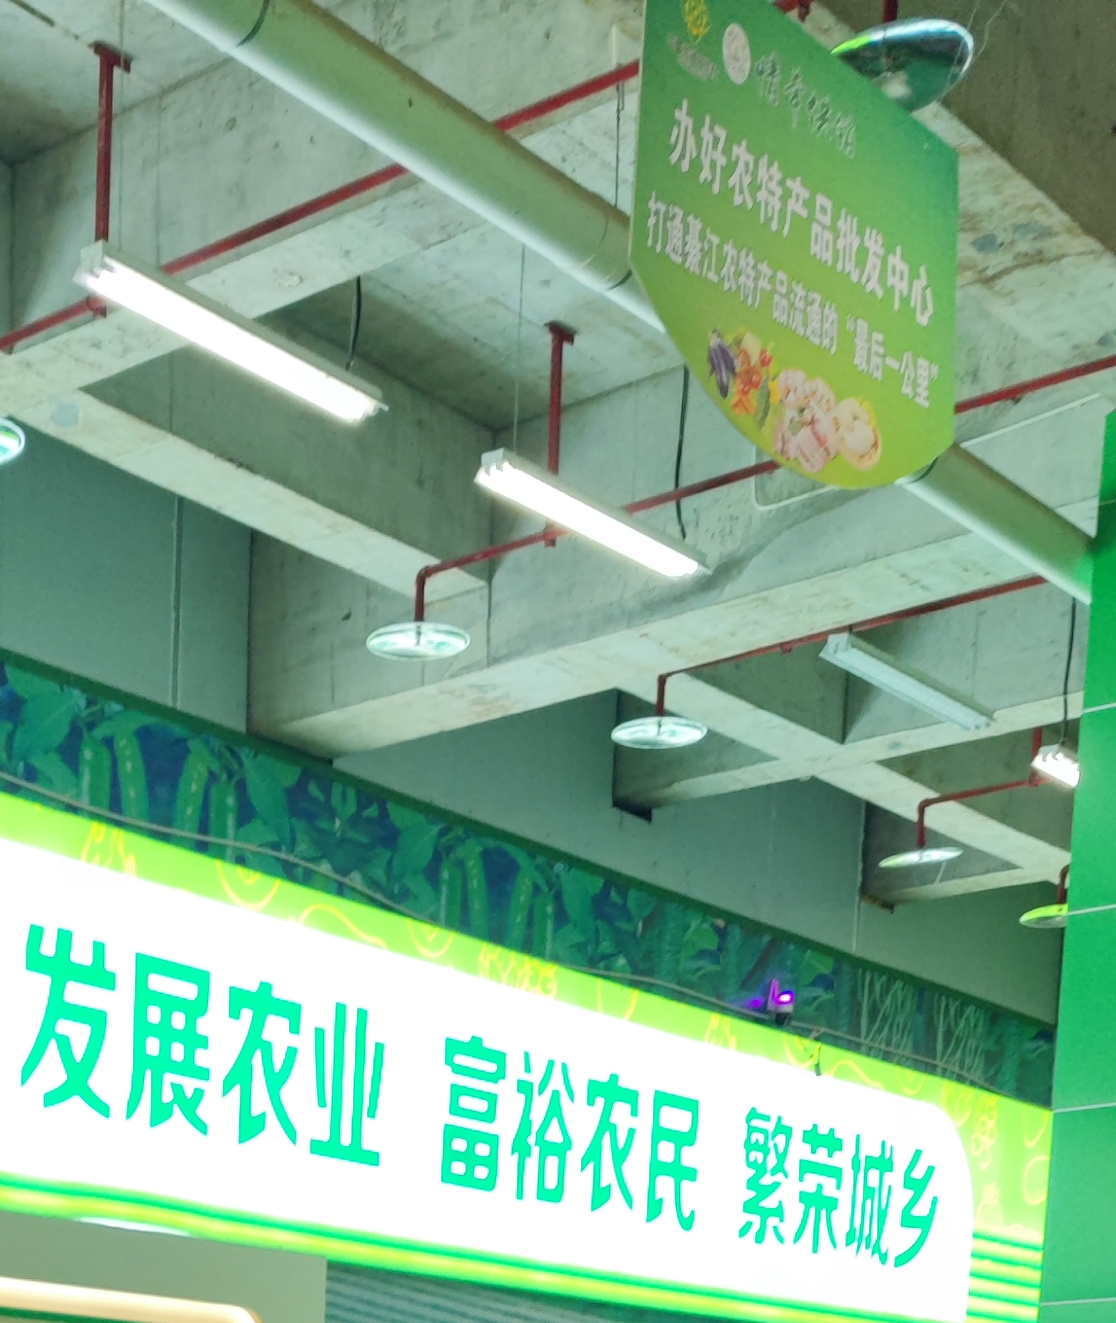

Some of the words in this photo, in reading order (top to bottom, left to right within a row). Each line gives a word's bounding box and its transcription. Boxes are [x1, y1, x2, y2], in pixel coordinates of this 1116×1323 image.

[668, 98, 935, 328] 办好农特产品批发中心
[20, 923, 385, 1168] 发展农业
[440, 1035, 700, 1232] 富裕农民
[738, 1106, 939, 1269] 繁荣城乡
